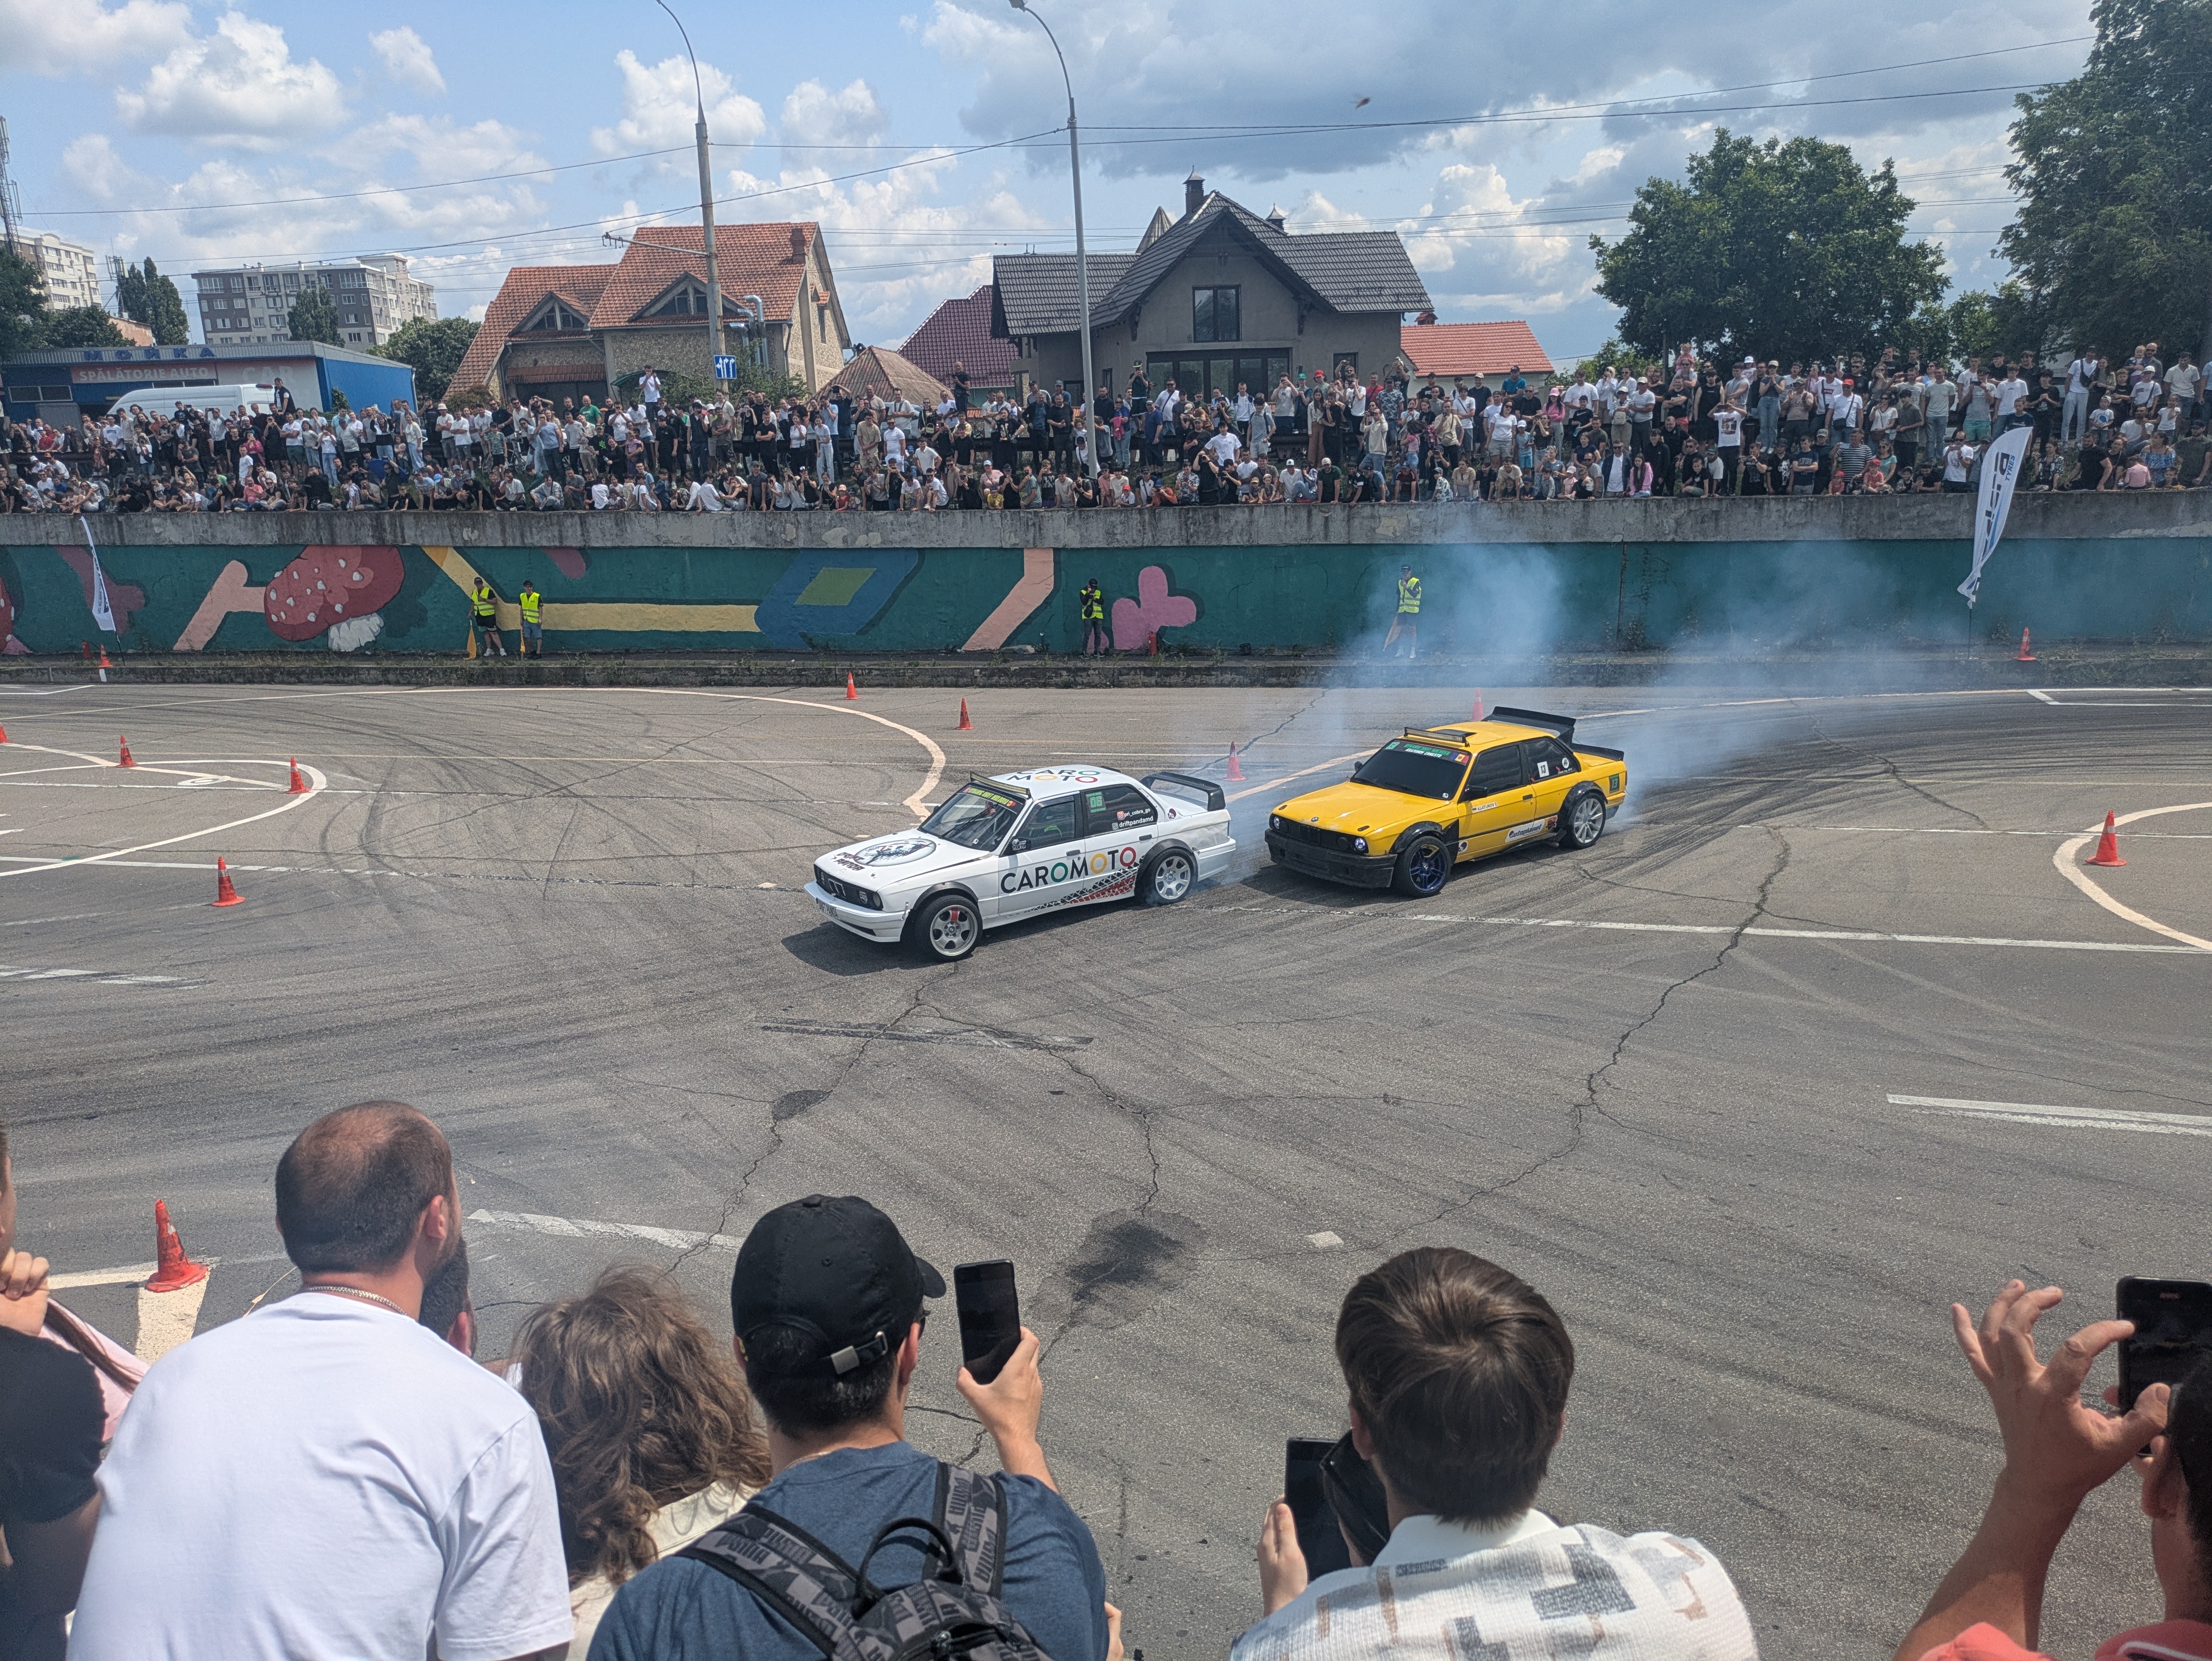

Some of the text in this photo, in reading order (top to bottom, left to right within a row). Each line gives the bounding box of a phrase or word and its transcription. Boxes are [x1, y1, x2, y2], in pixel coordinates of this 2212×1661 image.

[84, 346, 216, 361] МОЙКА
[79, 365, 210, 382] SPĂLĂTORIE AUTO
[242, 366, 295, 384] CAR
[2005, 455, 2015, 481] TYRES
[1540, 764, 1546, 774] 13
[1006, 775, 1098, 783] MOTO
[1090, 796, 1103, 808] 06
[1477, 803, 1494, 811] ASATUROV
[1119, 816, 1153, 828] driftpandamd
[1001, 847, 1136, 894] CAROMOTO
